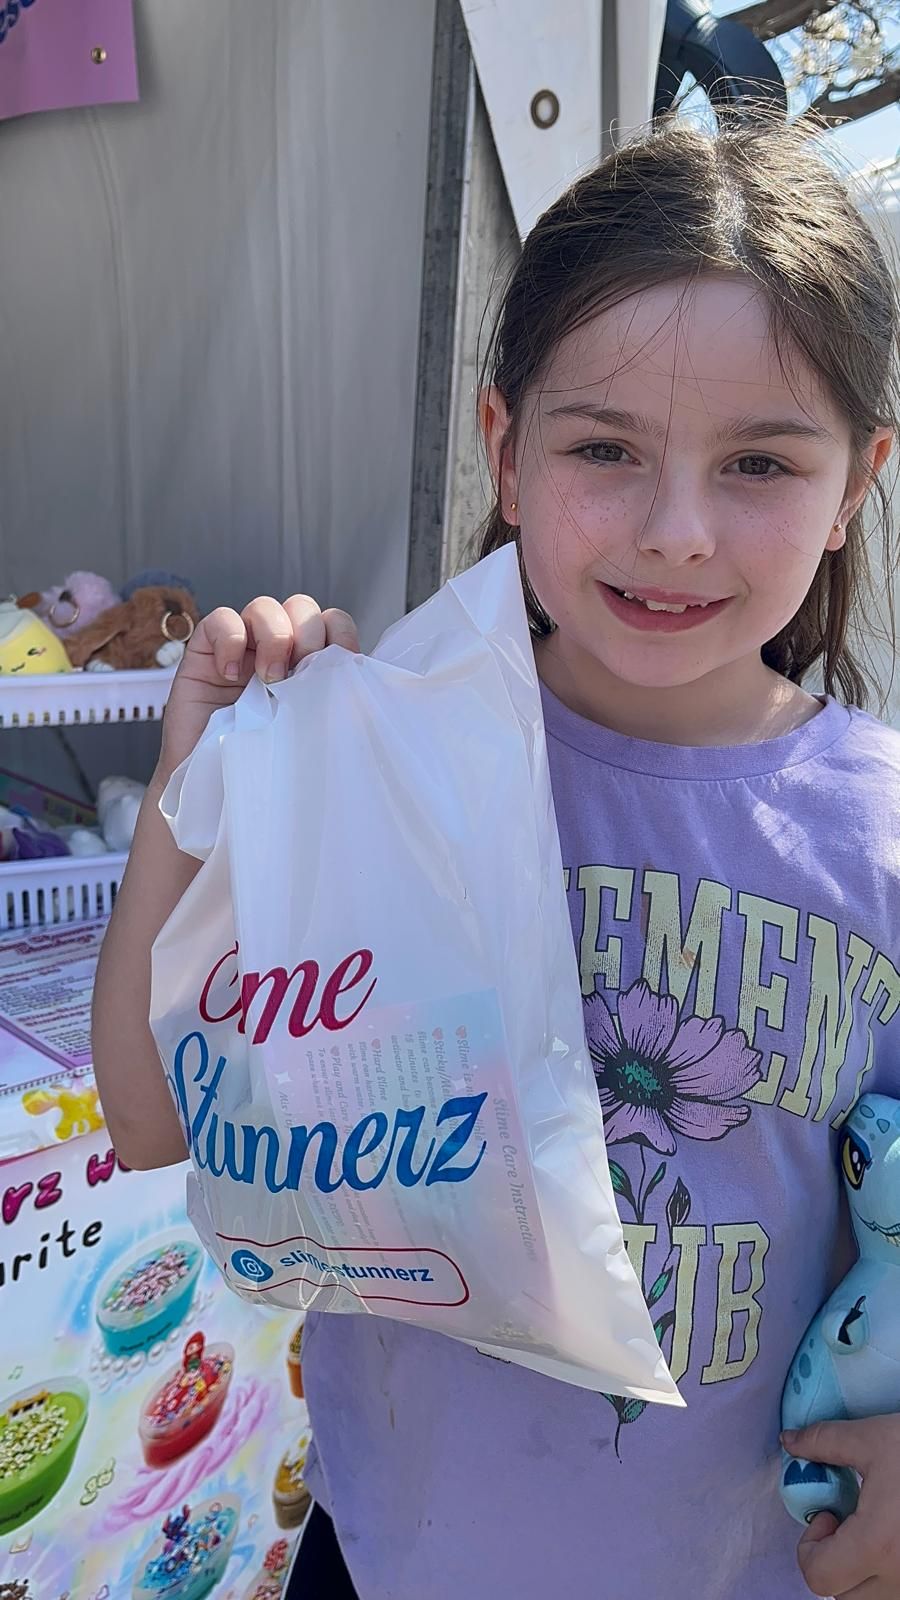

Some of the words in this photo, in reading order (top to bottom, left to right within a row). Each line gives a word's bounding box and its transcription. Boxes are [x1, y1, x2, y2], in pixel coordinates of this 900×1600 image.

[563, 864, 900, 1130] EMENT
[328, 1056, 344, 1078] Play
[372, 1048, 385, 1074] Hard
[406, 1048, 419, 1083] minutes
[456, 1038, 472, 1070] Slime
[335, 1079, 347, 1099] and
[377, 1075, 389, 1101] Slime
[398, 1074, 408, 1092] and
[173, 1031, 489, 1194] Stunnerz
[493, 1098, 511, 1140] Slime
[502, 1144, 518, 1179] Care
[2, 1171, 62, 1225] rz
[280, 1250, 434, 1282] slimestunnerz
